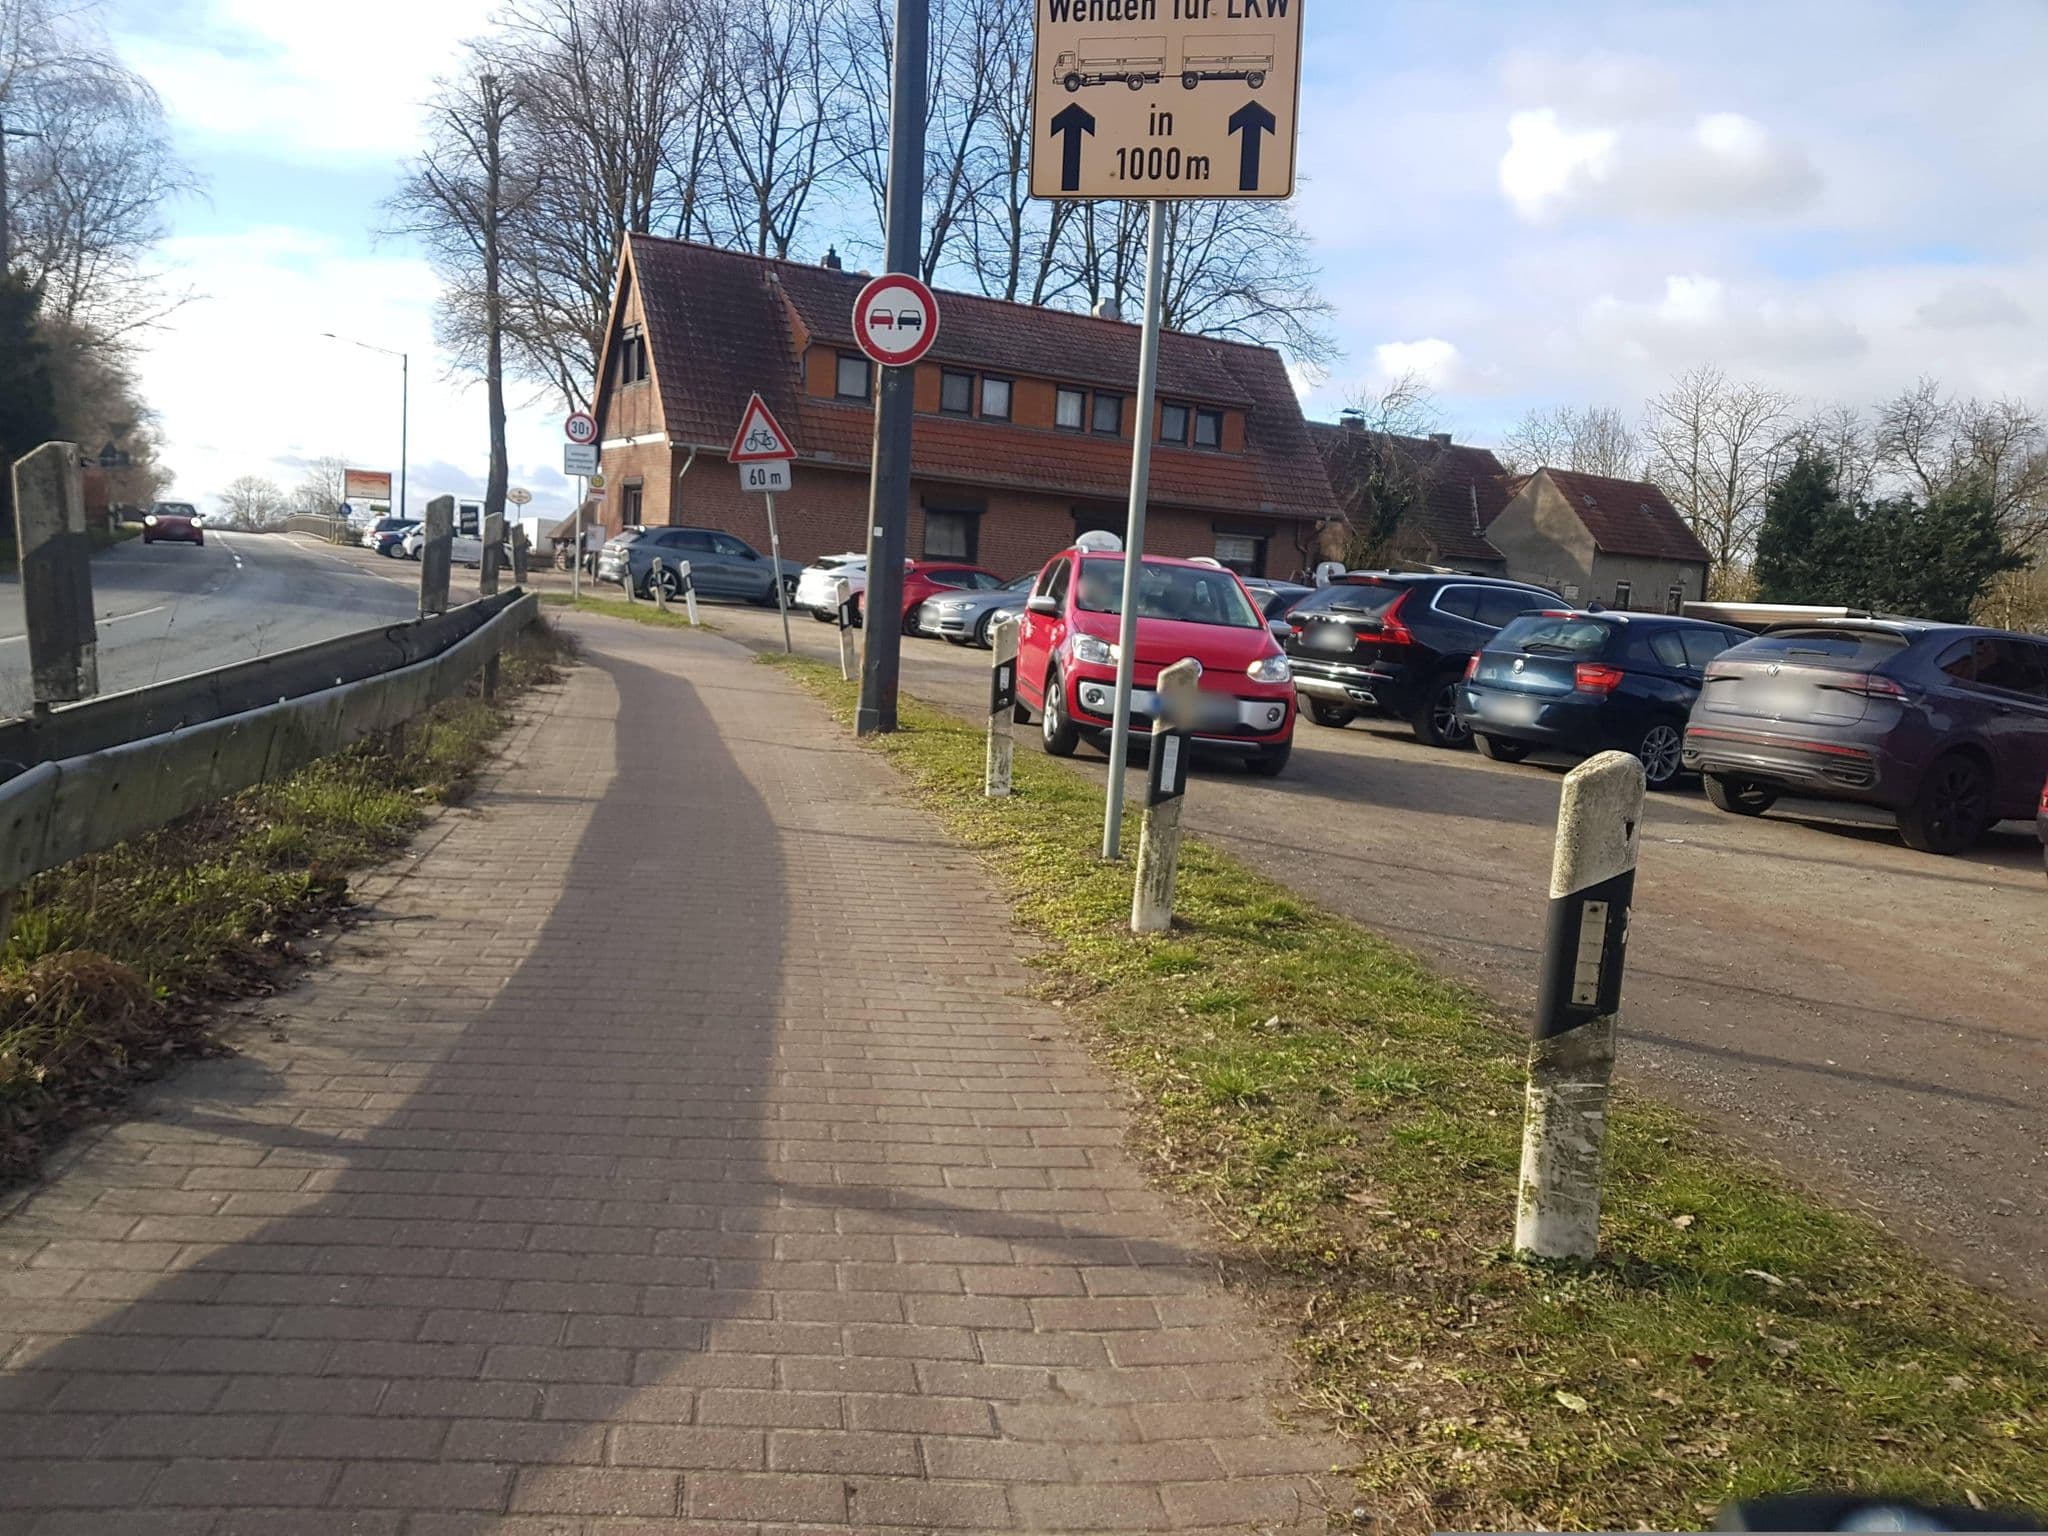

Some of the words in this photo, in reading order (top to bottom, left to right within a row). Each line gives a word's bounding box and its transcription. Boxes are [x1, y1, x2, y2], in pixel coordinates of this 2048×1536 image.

[1050, 0, 1156, 22] Wenden
[1227, 0, 1289, 19] LKW
[1149, 103, 1173, 136] in
[749, 468, 766, 486] 60
[770, 471, 782, 485] m
